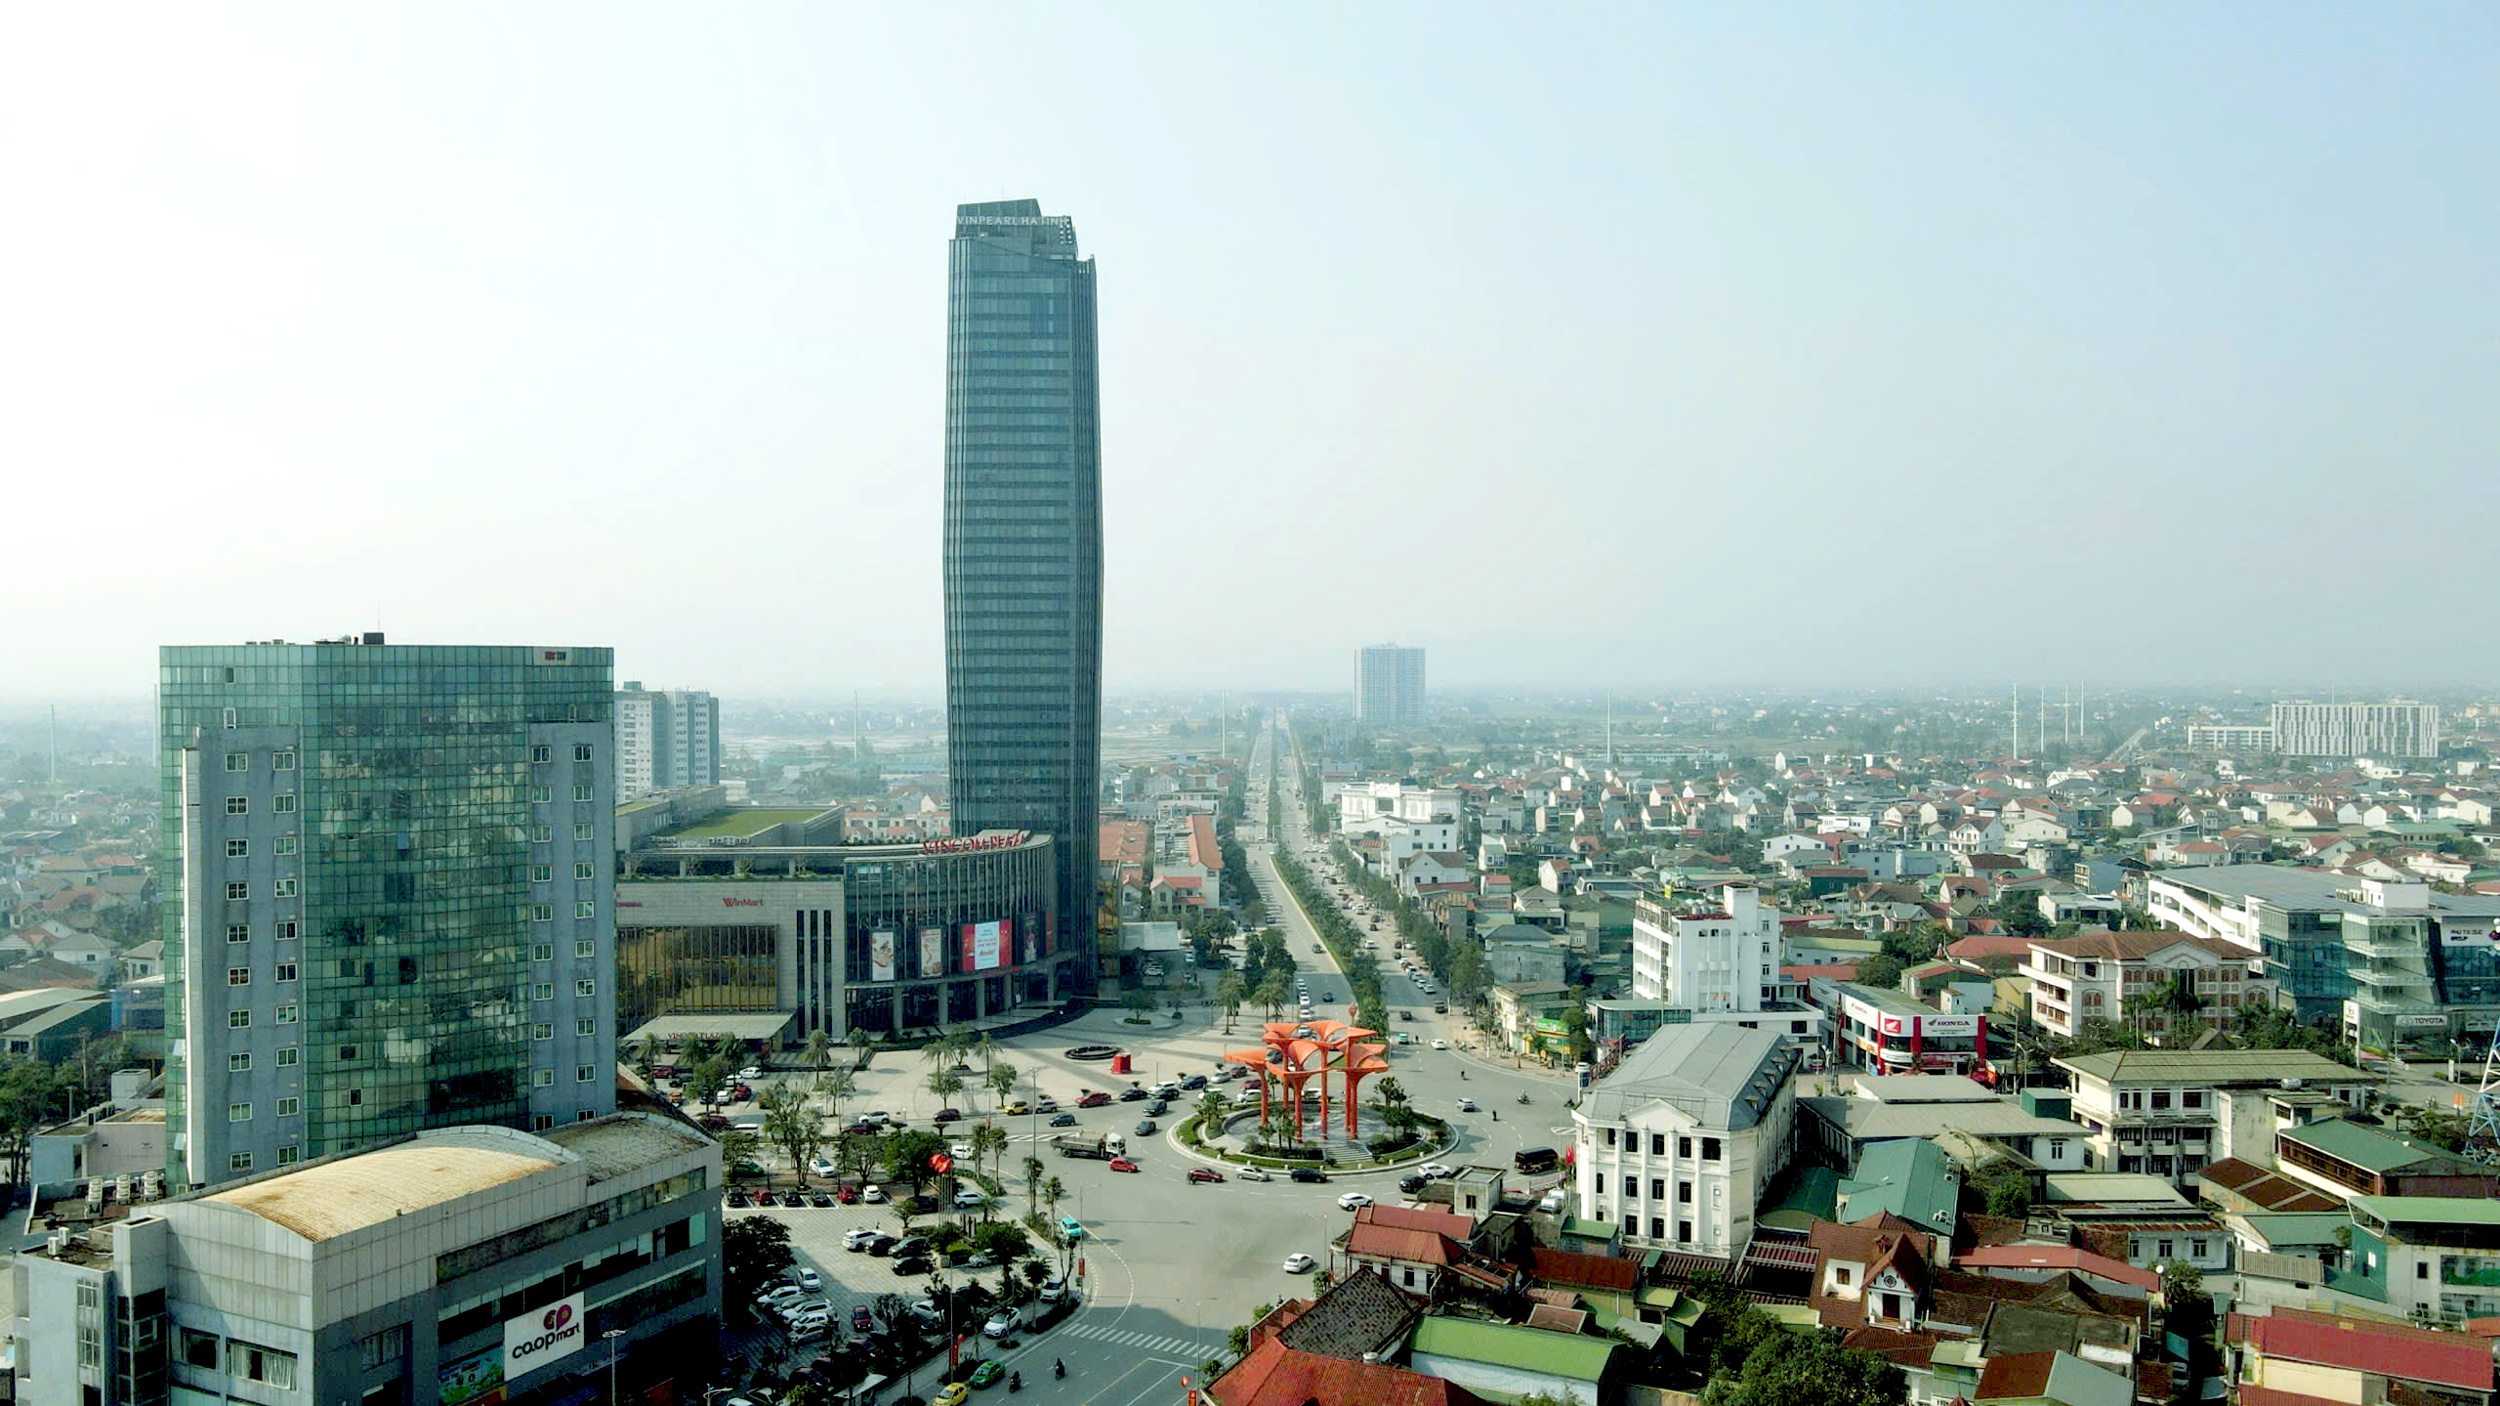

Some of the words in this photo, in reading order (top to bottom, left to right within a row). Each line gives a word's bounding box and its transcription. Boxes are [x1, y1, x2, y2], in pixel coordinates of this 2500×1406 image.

[957, 216, 1018, 225] VINPEARL
[922, 839, 984, 853] VINCOM
[991, 833, 1026, 849] PLAZA
[723, 898, 763, 907] WinMart
